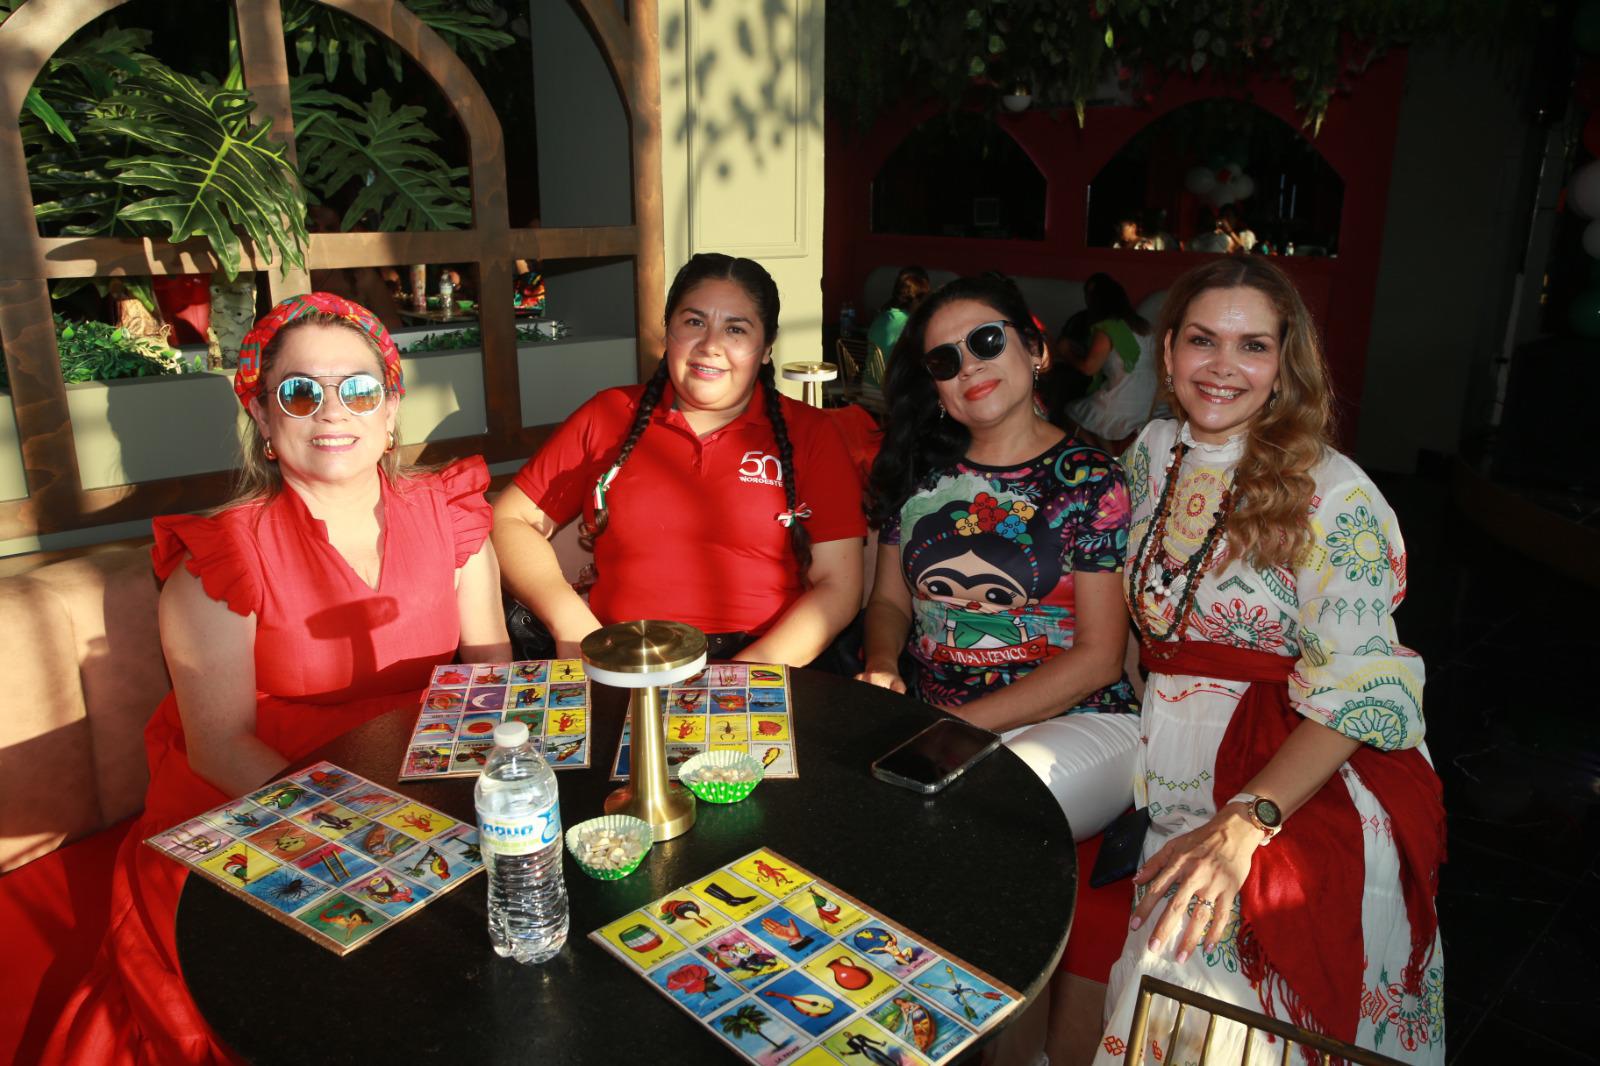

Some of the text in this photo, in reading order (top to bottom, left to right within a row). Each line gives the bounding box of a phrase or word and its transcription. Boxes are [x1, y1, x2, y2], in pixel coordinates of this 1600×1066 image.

[738, 451, 782, 481] 50
[738, 476, 783, 487] NOROESTE
[948, 647, 1027, 663] VIVA MEXICO
